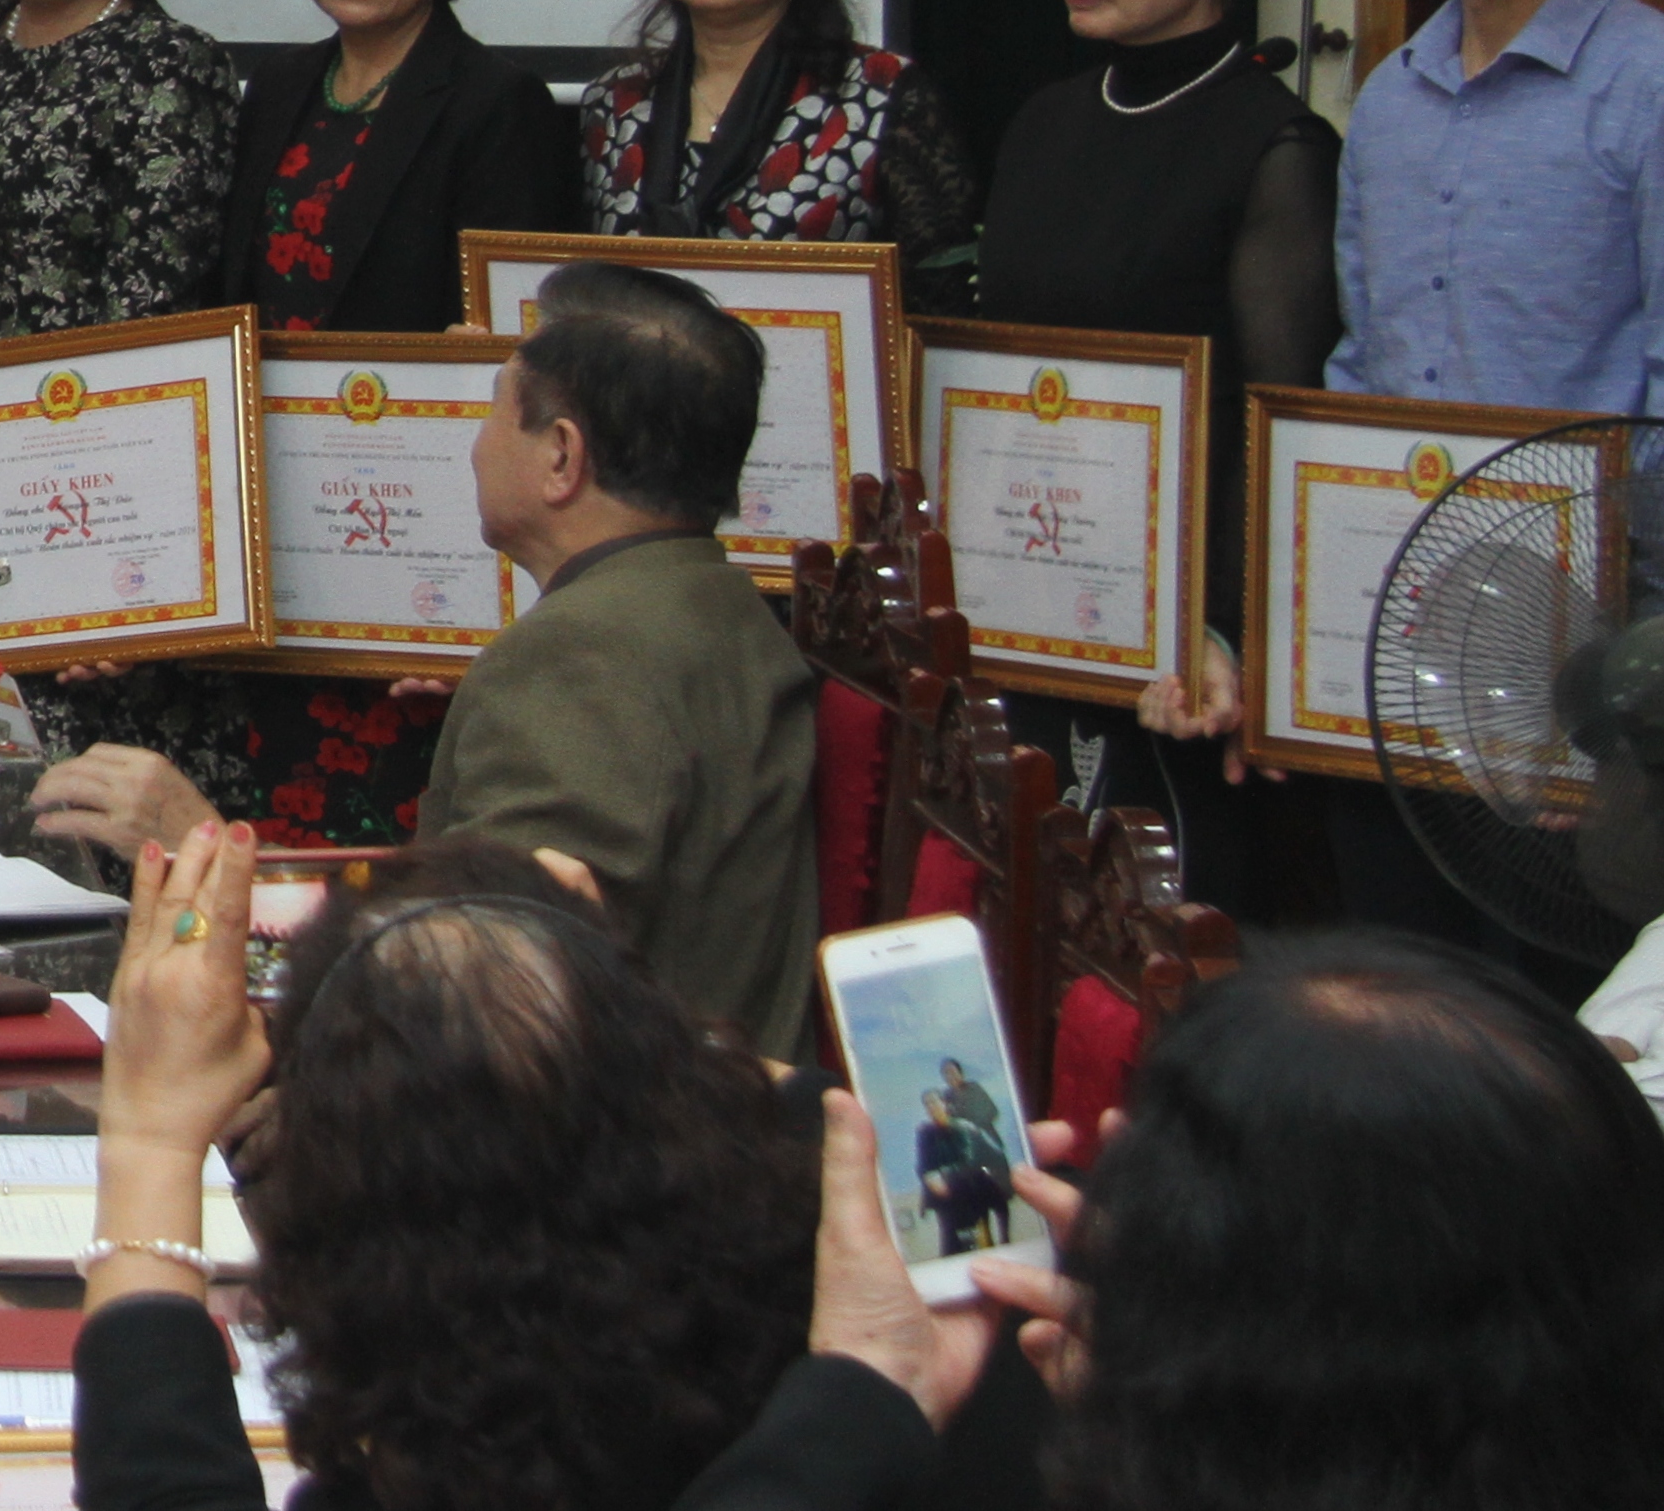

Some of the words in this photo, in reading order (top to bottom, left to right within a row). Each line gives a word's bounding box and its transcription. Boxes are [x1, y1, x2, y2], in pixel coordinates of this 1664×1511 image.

[19, 474, 61, 498] GIẤY
[69, 472, 116, 491] KHEN
[368, 482, 415, 499] KHEN
